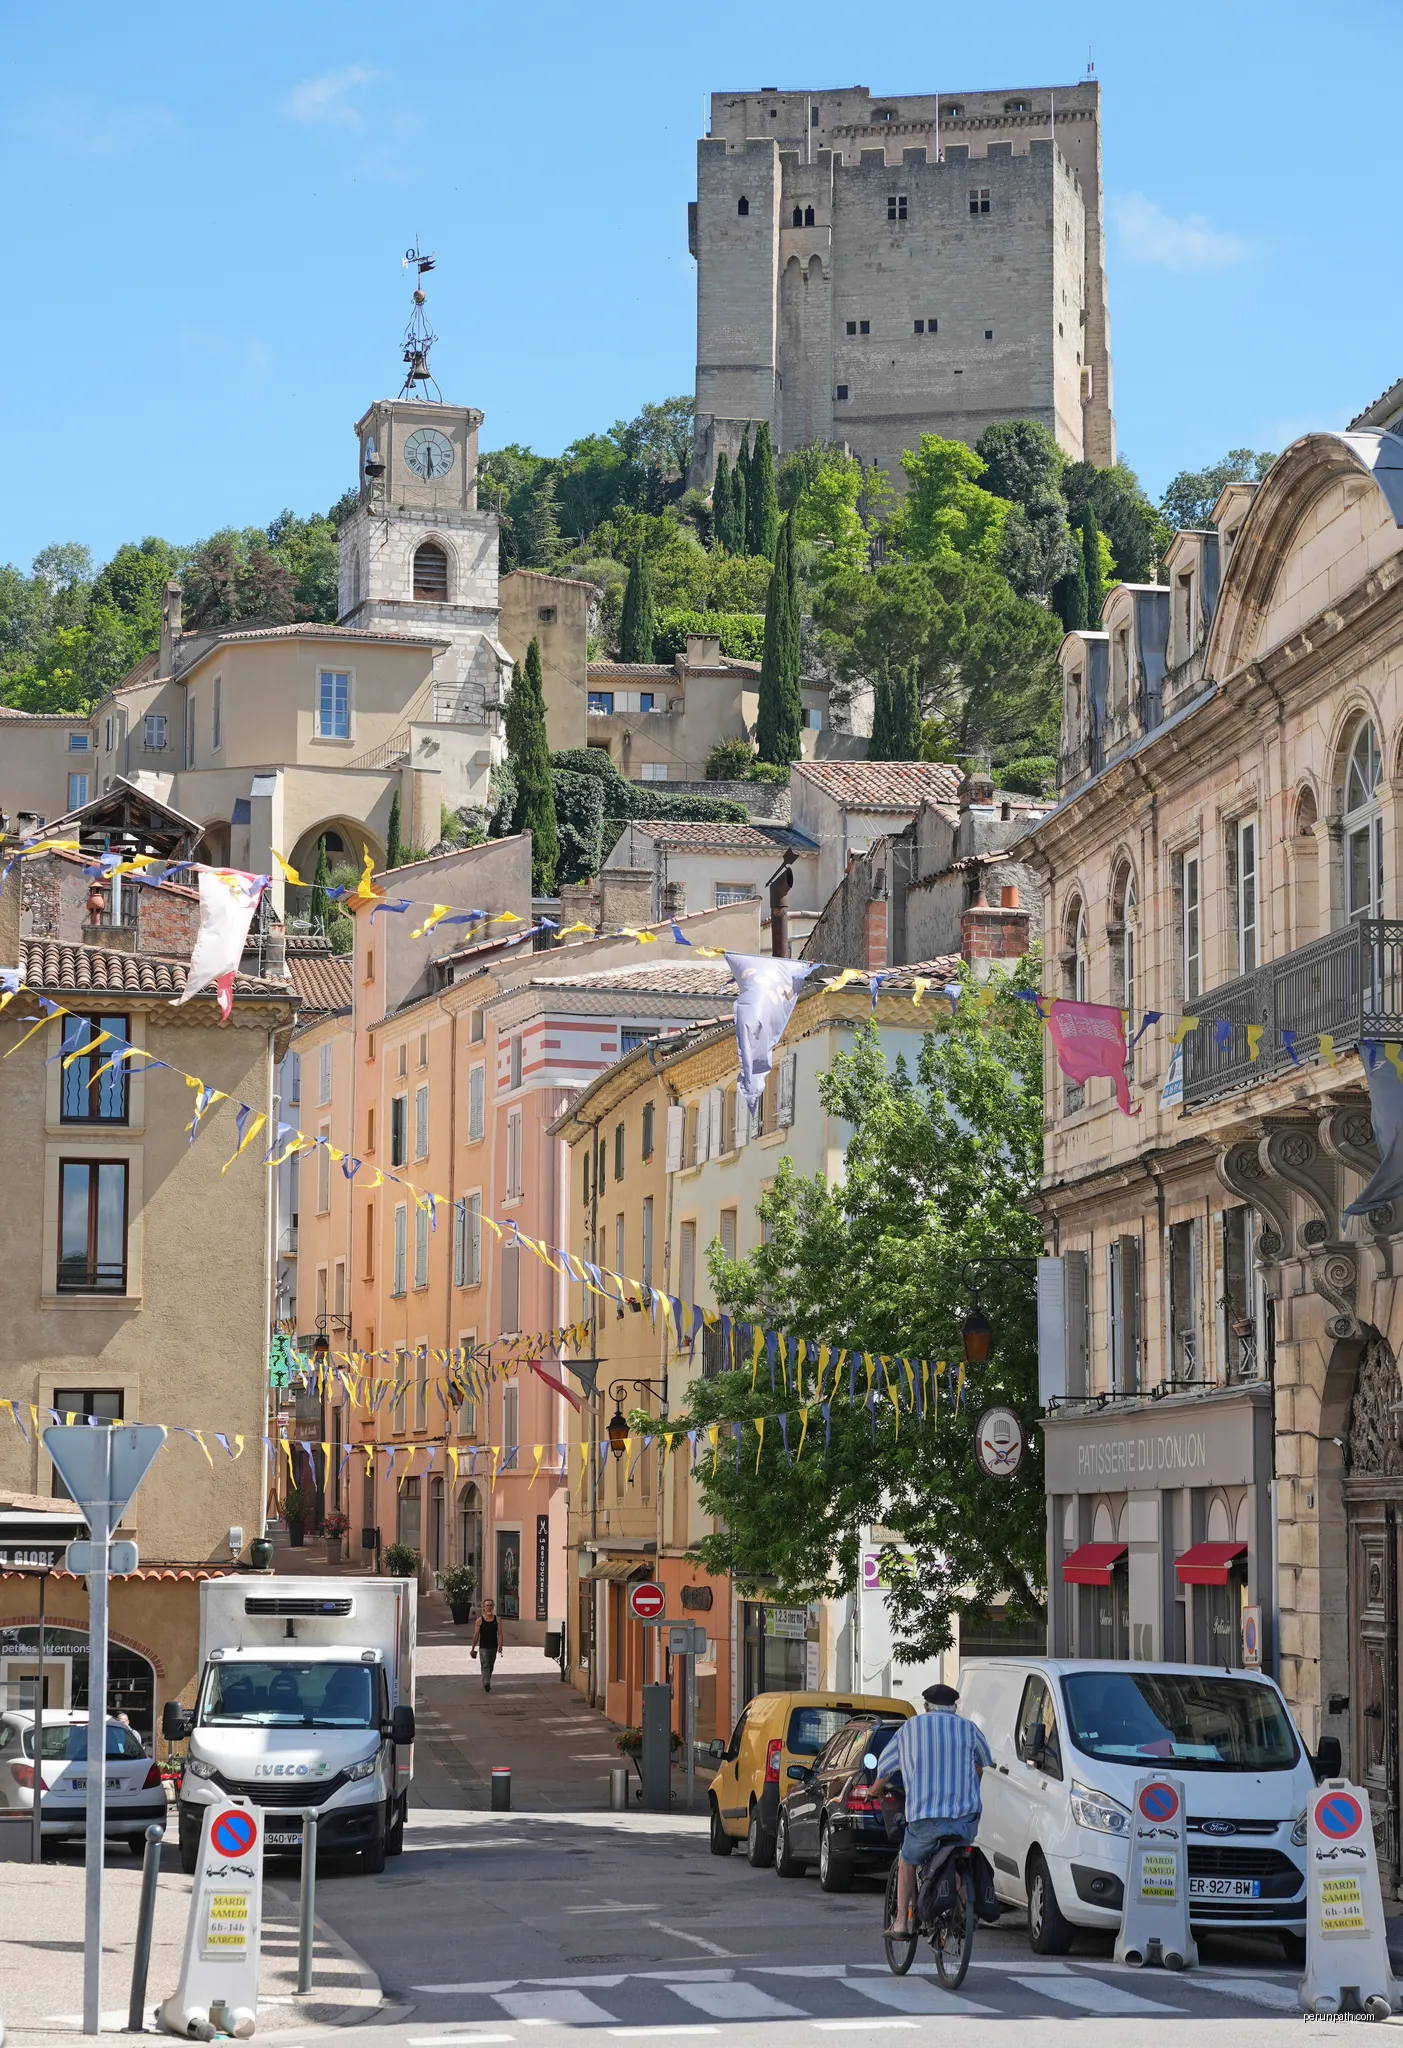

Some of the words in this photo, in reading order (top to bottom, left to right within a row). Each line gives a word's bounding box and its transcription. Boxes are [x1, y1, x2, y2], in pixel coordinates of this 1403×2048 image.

[1078, 1440, 1135, 1475] PATISSERIE
[1138, 1438, 1154, 1471] DU
[1157, 1432, 1207, 1469] DONJON
[14, 1551, 54, 1567] GLOBE
[255, 1765, 309, 1777] IVECO
[1209, 1822, 1229, 1832] Ford
[264, 1834, 298, 1844] -940-VP
[1146, 1857, 1174, 1865] MARDI
[1143, 1867, 1175, 1875] SAMEDI
[1189, 1880, 1251, 1895] ER-927-BW
[1323, 1880, 1357, 1891] MARDI
[213, 1897, 246, 1906] MARDI
[1321, 1893, 1361, 1904] SAMEDI
[210, 1910, 248, 1919] SAMEDI
